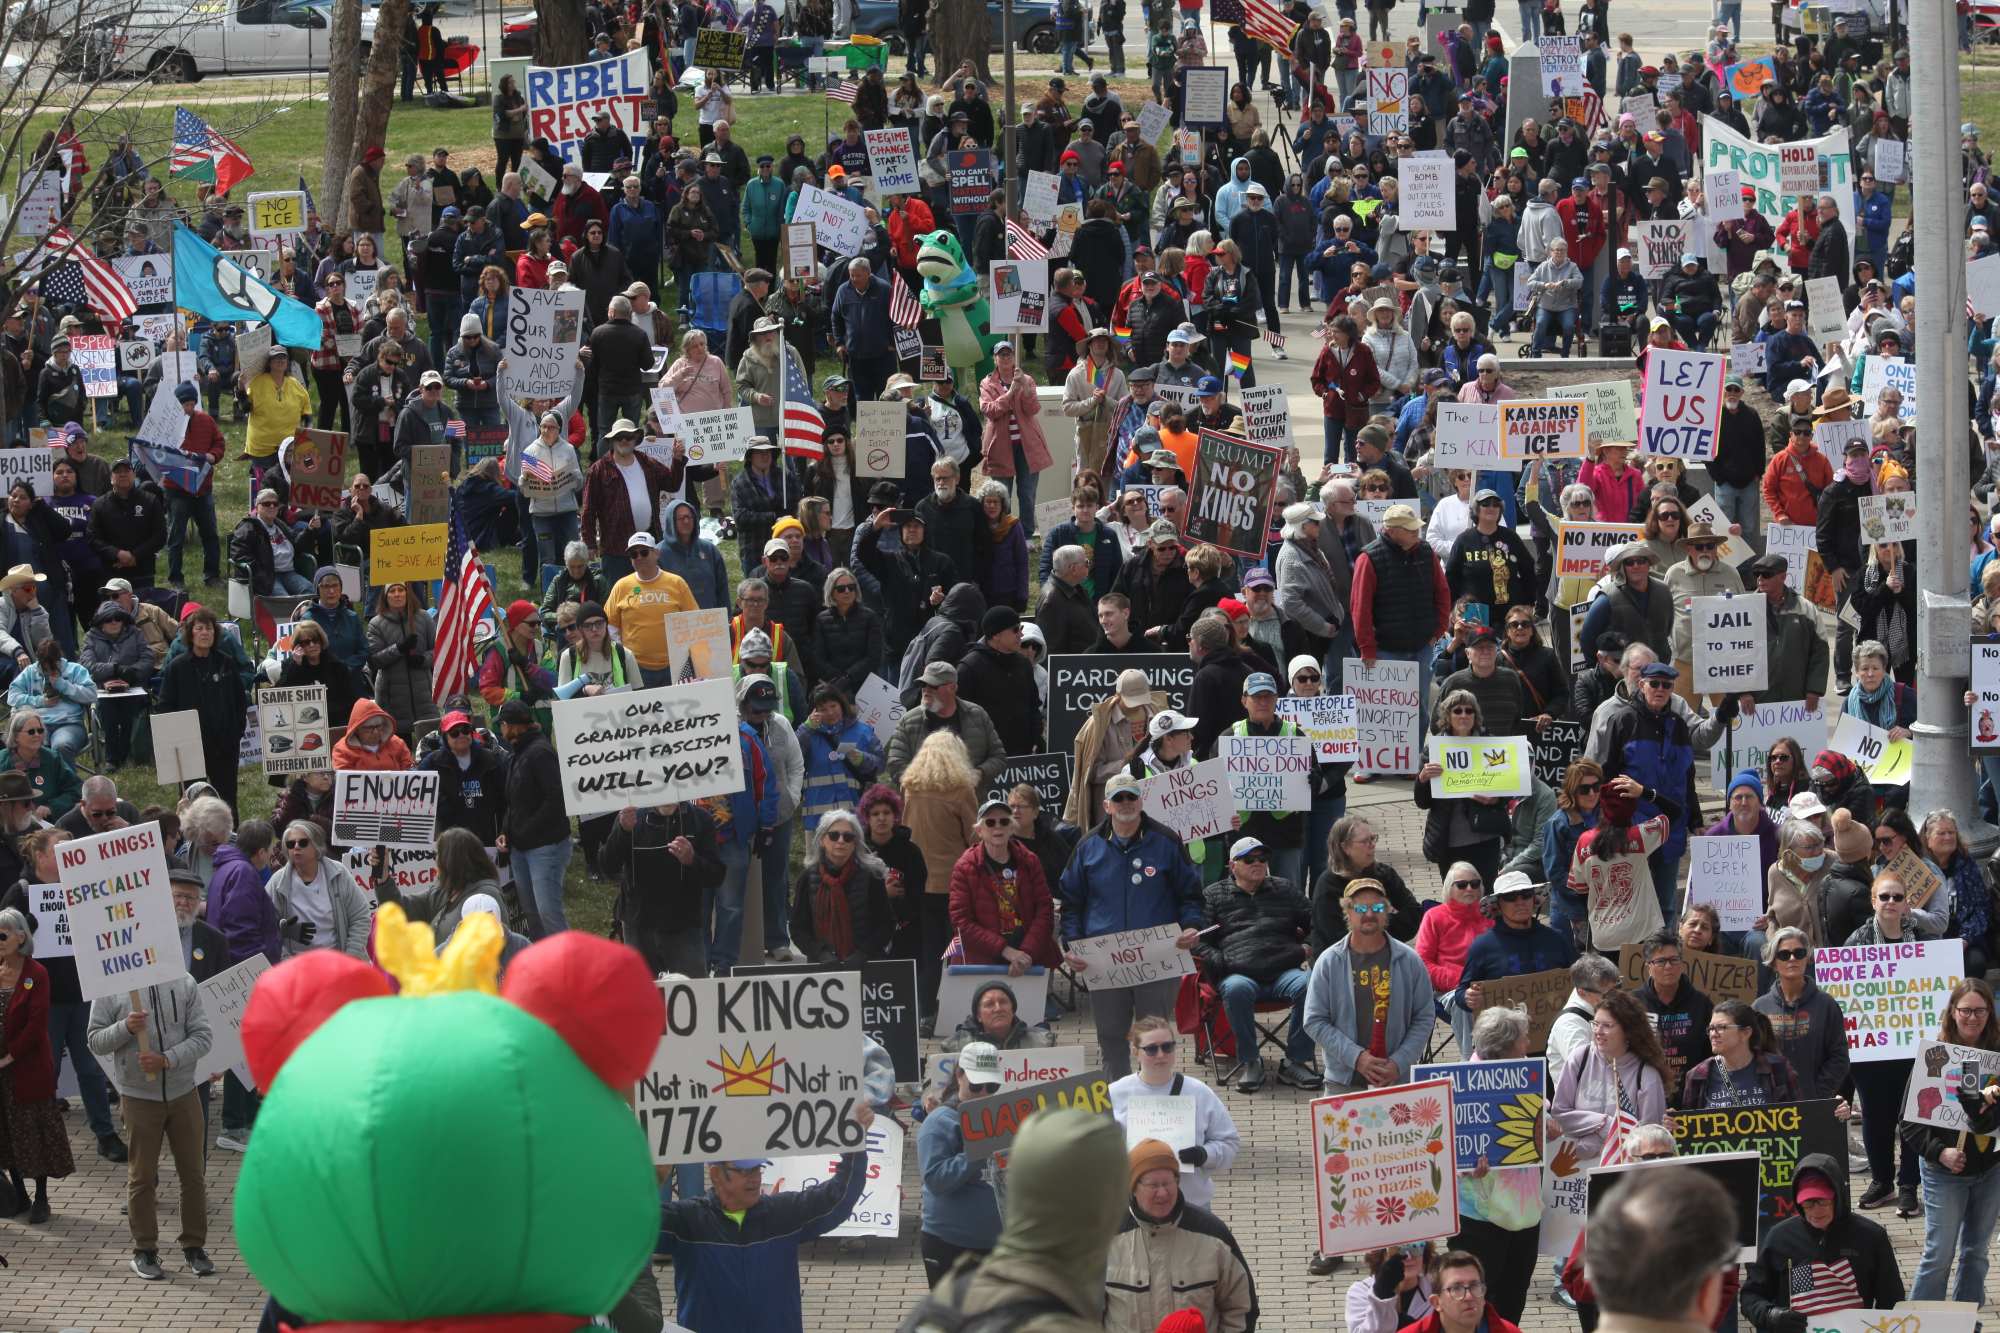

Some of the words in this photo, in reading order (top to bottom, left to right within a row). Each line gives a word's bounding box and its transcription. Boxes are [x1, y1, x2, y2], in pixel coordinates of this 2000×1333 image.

[700, 30, 725, 44] RISE
[1540, 46, 1561, 56] DOZY
[1541, 55, 1578, 65] DESTROY
[528, 57, 644, 108] REBEL
[1368, 69, 1408, 100] NO
[1370, 110, 1407, 134] KING
[867, 131, 910, 143] REGIME
[870, 143, 911, 156] CHANGE
[1781, 147, 1813, 164] HOLD
[1882, 144, 1899, 157] ICE
[875, 155, 908, 166] STARTS
[1184, 154, 1197, 162] USA
[886, 165, 897, 174] AT
[1414, 173, 1438, 181] BOMB
[1781, 164, 1817, 178] REPUBLICANS
[878, 173, 914, 188] HOME
[952, 175, 990, 188] SPELL
[1408, 183, 1422, 191] YOUR
[1714, 175, 1729, 188] ICE
[1781, 179, 1818, 193] ACCOUNTABLE
[267, 198, 289, 211] NO
[811, 189, 857, 222] Democracy
[1715, 194, 1738, 208] IRAN
[261, 212, 293, 229] ICE
[1414, 209, 1443, 218] DONALD
[822, 211, 846, 229] NOT
[850, 225, 859, 236] a
[1651, 224, 1680, 239] NO
[833, 233, 856, 255] Sport
[1021, 298, 1044, 307] KINGS
[1811, 291, 1839, 302] President
[898, 337, 920, 351] KINGS
[529, 361, 561, 380] AND
[923, 365, 944, 374] NOPE
[1659, 359, 1714, 390] LET
[506, 376, 574, 396] DAUGHTERS
[1242, 387, 1268, 401] Trump
[1269, 386, 1276, 397] is
[1244, 398, 1272, 414] Kruel
[1662, 394, 1706, 425] US
[685, 417, 696, 427] THE
[699, 414, 721, 425] ORANGE
[723, 412, 738, 422] IDIOT
[1246, 411, 1288, 428] Korrupt
[1445, 410, 1468, 424] The
[1505, 406, 1580, 423] KANSANS
[725, 421, 739, 431] KING
[859, 427, 902, 438] American
[1248, 424, 1286, 441] KLOWN
[1508, 418, 1578, 436] AGAINST
[1442, 442, 1456, 456] IS
[1524, 433, 1560, 456] ICE
[1645, 426, 1714, 456] VOTE
[1204, 438, 1272, 470] TRUMP
[1210, 457, 1255, 492] NO
[290, 482, 341, 510] KINGS
[1860, 497, 1874, 509] CAT
[1199, 485, 1257, 530] KINGS
[1862, 506, 1884, 520] KINGS
[1890, 521, 1910, 534] ONLY!
[378, 531, 400, 547] Save
[404, 531, 416, 542] us
[421, 529, 442, 542] from
[1563, 531, 1586, 546] NO
[376, 554, 391, 569] the
[396, 553, 421, 568] SAVE
[640, 592, 670, 603] LOVE
[697, 611, 721, 627] NOT
[1707, 611, 1752, 629] JAIL
[675, 626, 724, 644] ORANGE
[1707, 641, 1722, 651] TO
[1730, 640, 1753, 650] THE
[1982, 648, 1999, 659] No
[1349, 664, 1376, 682] THE
[1707, 664, 1754, 678] CHIEF
[261, 691, 293, 704] SAME
[296, 689, 323, 702] SHIT
[1291, 699, 1312, 712] THE
[1315, 697, 1355, 711] PEOPLE
[1982, 691, 1999, 702] No
[625, 700, 664, 717] OUR
[1312, 709, 1344, 720] NEVER
[1313, 715, 1349, 727] FORGET
[1751, 707, 1776, 728] NO
[574, 713, 721, 745] GRANDPARENTS
[1383, 729, 1408, 743] THE
[567, 747, 646, 768] FOUGHT
[649, 734, 731, 758] FASCISM
[1230, 738, 1303, 757] DEPOSE
[1322, 742, 1358, 755] QUIET
[1857, 735, 1883, 760] NO
[266, 758, 309, 773] DIFFERENT
[311, 756, 328, 770] HAT
[1226, 757, 1270, 773] KING
[1446, 751, 1468, 769] NO
[578, 769, 653, 793] WILL
[662, 756, 729, 784] YOU?
[1237, 775, 1283, 789] TRUTH
[345, 774, 438, 804] ENOUGH
[1160, 779, 1218, 810] KINGS
[1235, 787, 1287, 801] SOCIAL
[1245, 799, 1282, 810] LIES!
[62, 848, 86, 868] NO
[98, 831, 155, 860] KINGS!
[1707, 842, 1752, 859] DUMP
[1702, 861, 1750, 876] DEREK
[66, 868, 150, 906] ESPECIALLY
[1714, 880, 1748, 894] 2026
[1906, 868, 1925, 893] WITH
[43, 890, 55, 900] NO
[1709, 899, 1723, 909] NO
[1725, 898, 1754, 909] KINGS!
[105, 901, 135, 923] THE
[1725, 915, 1746, 925] THEM
[96, 922, 140, 952] LYIN'
[1069, 940, 1093, 957] WE
[1094, 938, 1109, 949] the
[1114, 923, 1175, 948] PEOPLE
[101, 947, 157, 976] KING!!
[1815, 946, 1891, 964] ABOLISH
[1894, 943, 1926, 961] ICE
[1106, 962, 1157, 987] KING
[1816, 965, 1868, 983] WOKE
[717, 976, 850, 1034] KINGS
[1877, 995, 1933, 1013] BITCH
[1889, 1013, 1914, 1029] ON
[639, 1070, 681, 1102] Not
[689, 1078, 708, 1099] in
[783, 1061, 831, 1093] Not
[837, 1069, 858, 1091] in
[1469, 1066, 1530, 1093] KANSANS
[1753, 1086, 1763, 1096] is
[1129, 1099, 1149, 1111] DUE
[1156, 1099, 1193, 1111] PROCESS
[639, 1104, 723, 1157] 1776
[765, 1097, 864, 1151] 2026
[961, 1098, 1034, 1142] LIAR
[1128, 1116, 1151, 1127] THIN
[1160, 1115, 1185, 1126] LINE
[1671, 1106, 1803, 1139] STRONG
[1351, 1138, 1373, 1152] no
[1377, 1126, 1424, 1147] kings
[1350, 1156, 1370, 1169] no
[1373, 1146, 1427, 1166] fascists
[1351, 1169, 1371, 1182] no
[1375, 1159, 1427, 1181] tyrants
[1352, 1185, 1375, 1199] no
[1378, 1175, 1422, 1196] nazis
